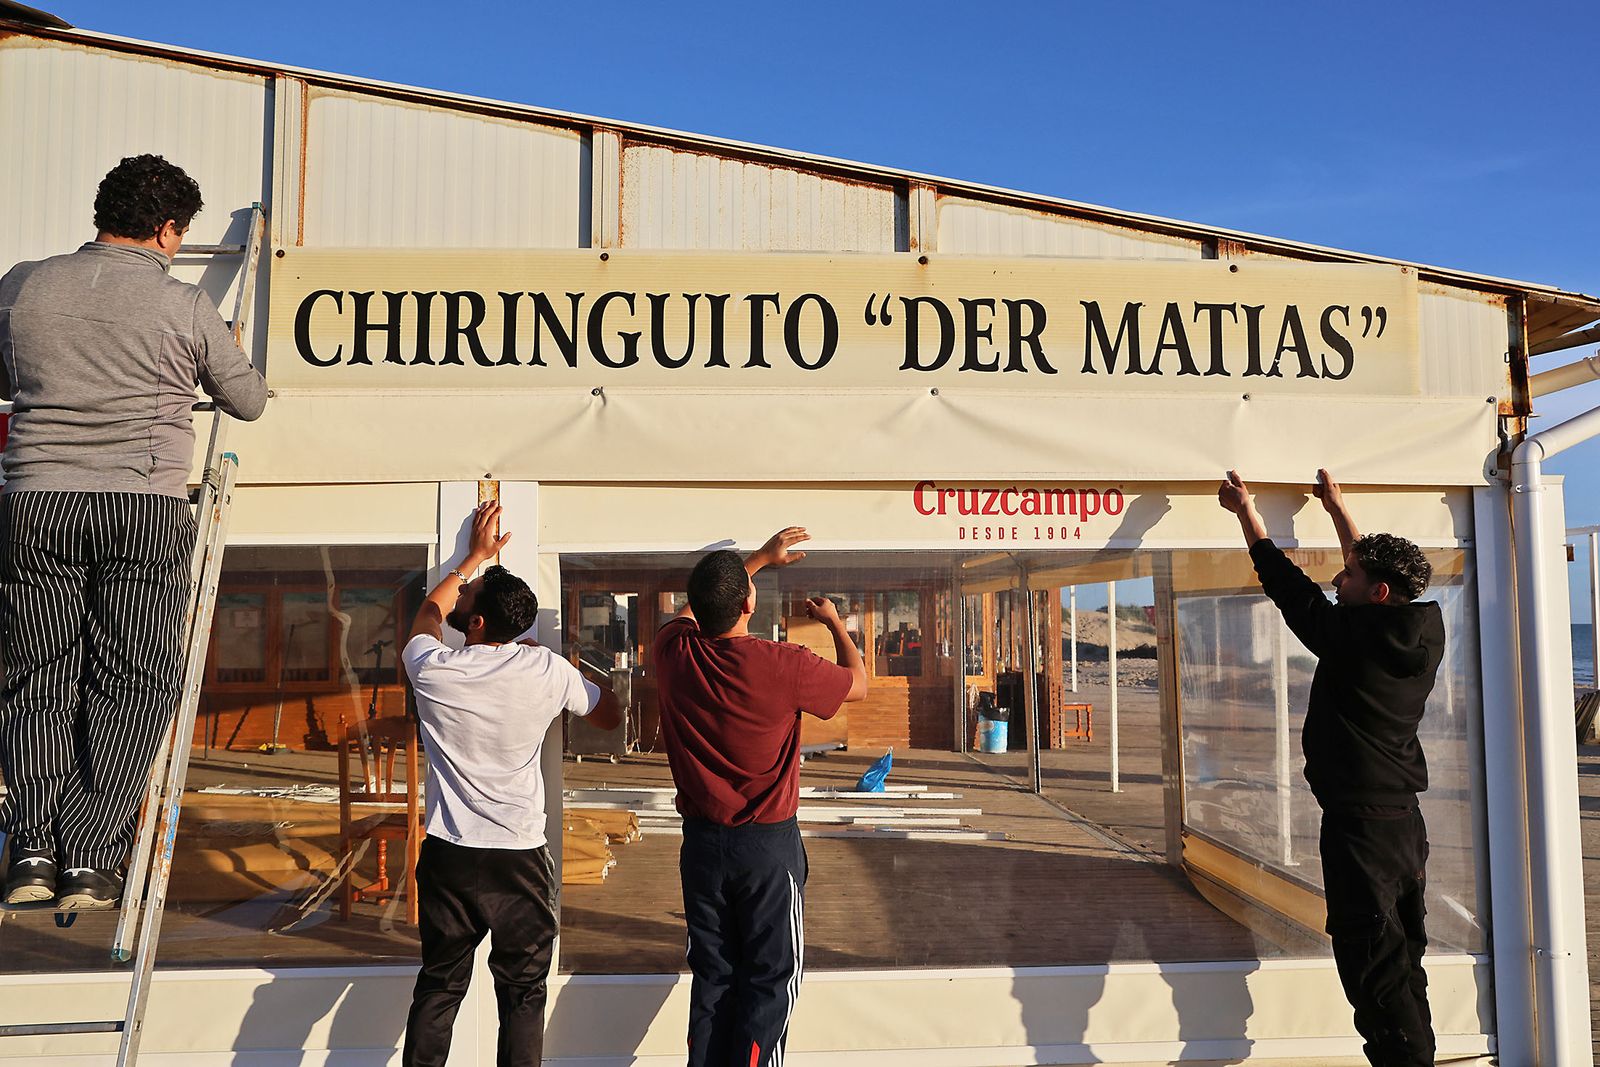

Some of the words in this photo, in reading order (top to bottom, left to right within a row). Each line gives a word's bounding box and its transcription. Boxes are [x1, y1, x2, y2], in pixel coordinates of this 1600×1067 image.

[294, 289, 839, 371] CHIRINGUITO
[864, 292, 1059, 375] “DER
[1079, 300, 1388, 381] MATIAS”
[913, 480, 1124, 523] Cruzcampo
[958, 526, 1018, 540] DESDE
[1034, 526, 1081, 540] 1904
